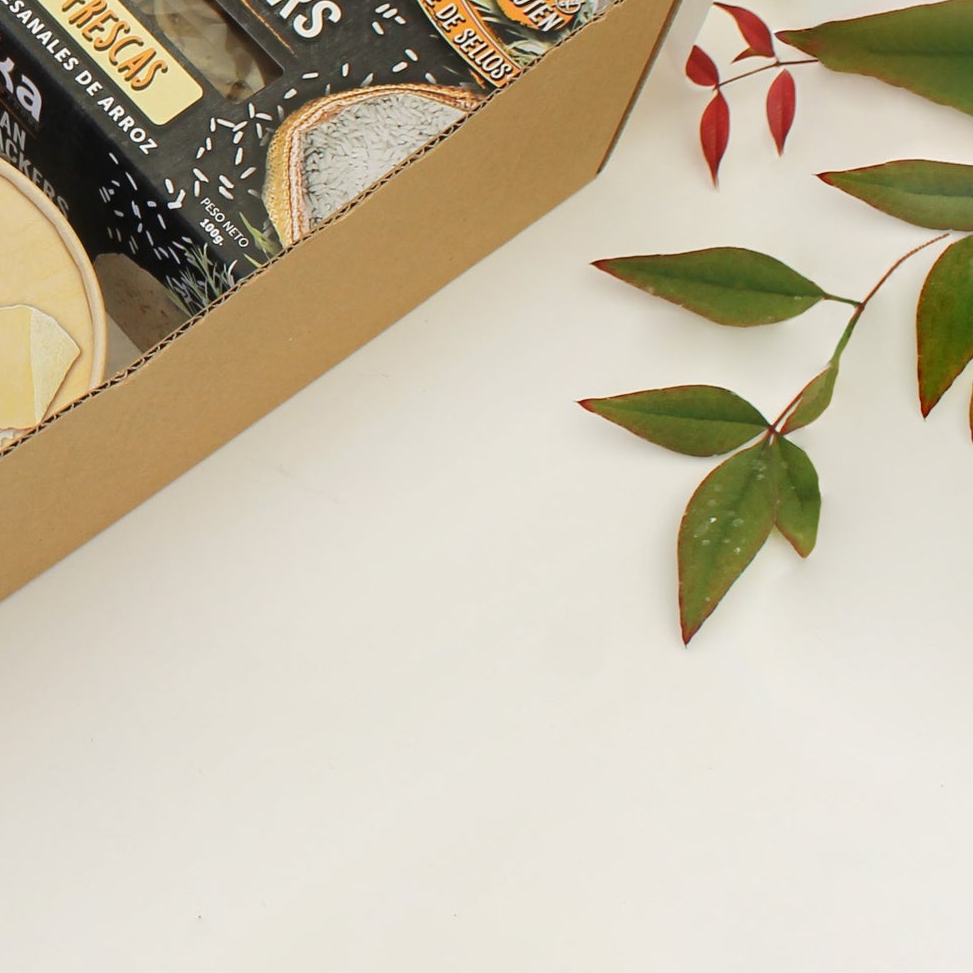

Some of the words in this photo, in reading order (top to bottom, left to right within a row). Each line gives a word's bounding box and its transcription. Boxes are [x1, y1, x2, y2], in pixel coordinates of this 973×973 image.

[435, 1, 466, 32] DE
[453, 27, 513, 82] SELLOS
[75, 70, 103, 96] DE
[97, 92, 159, 155] ARROZ
[200, 197, 225, 223] PESO
[222, 220, 249, 247] NETO
